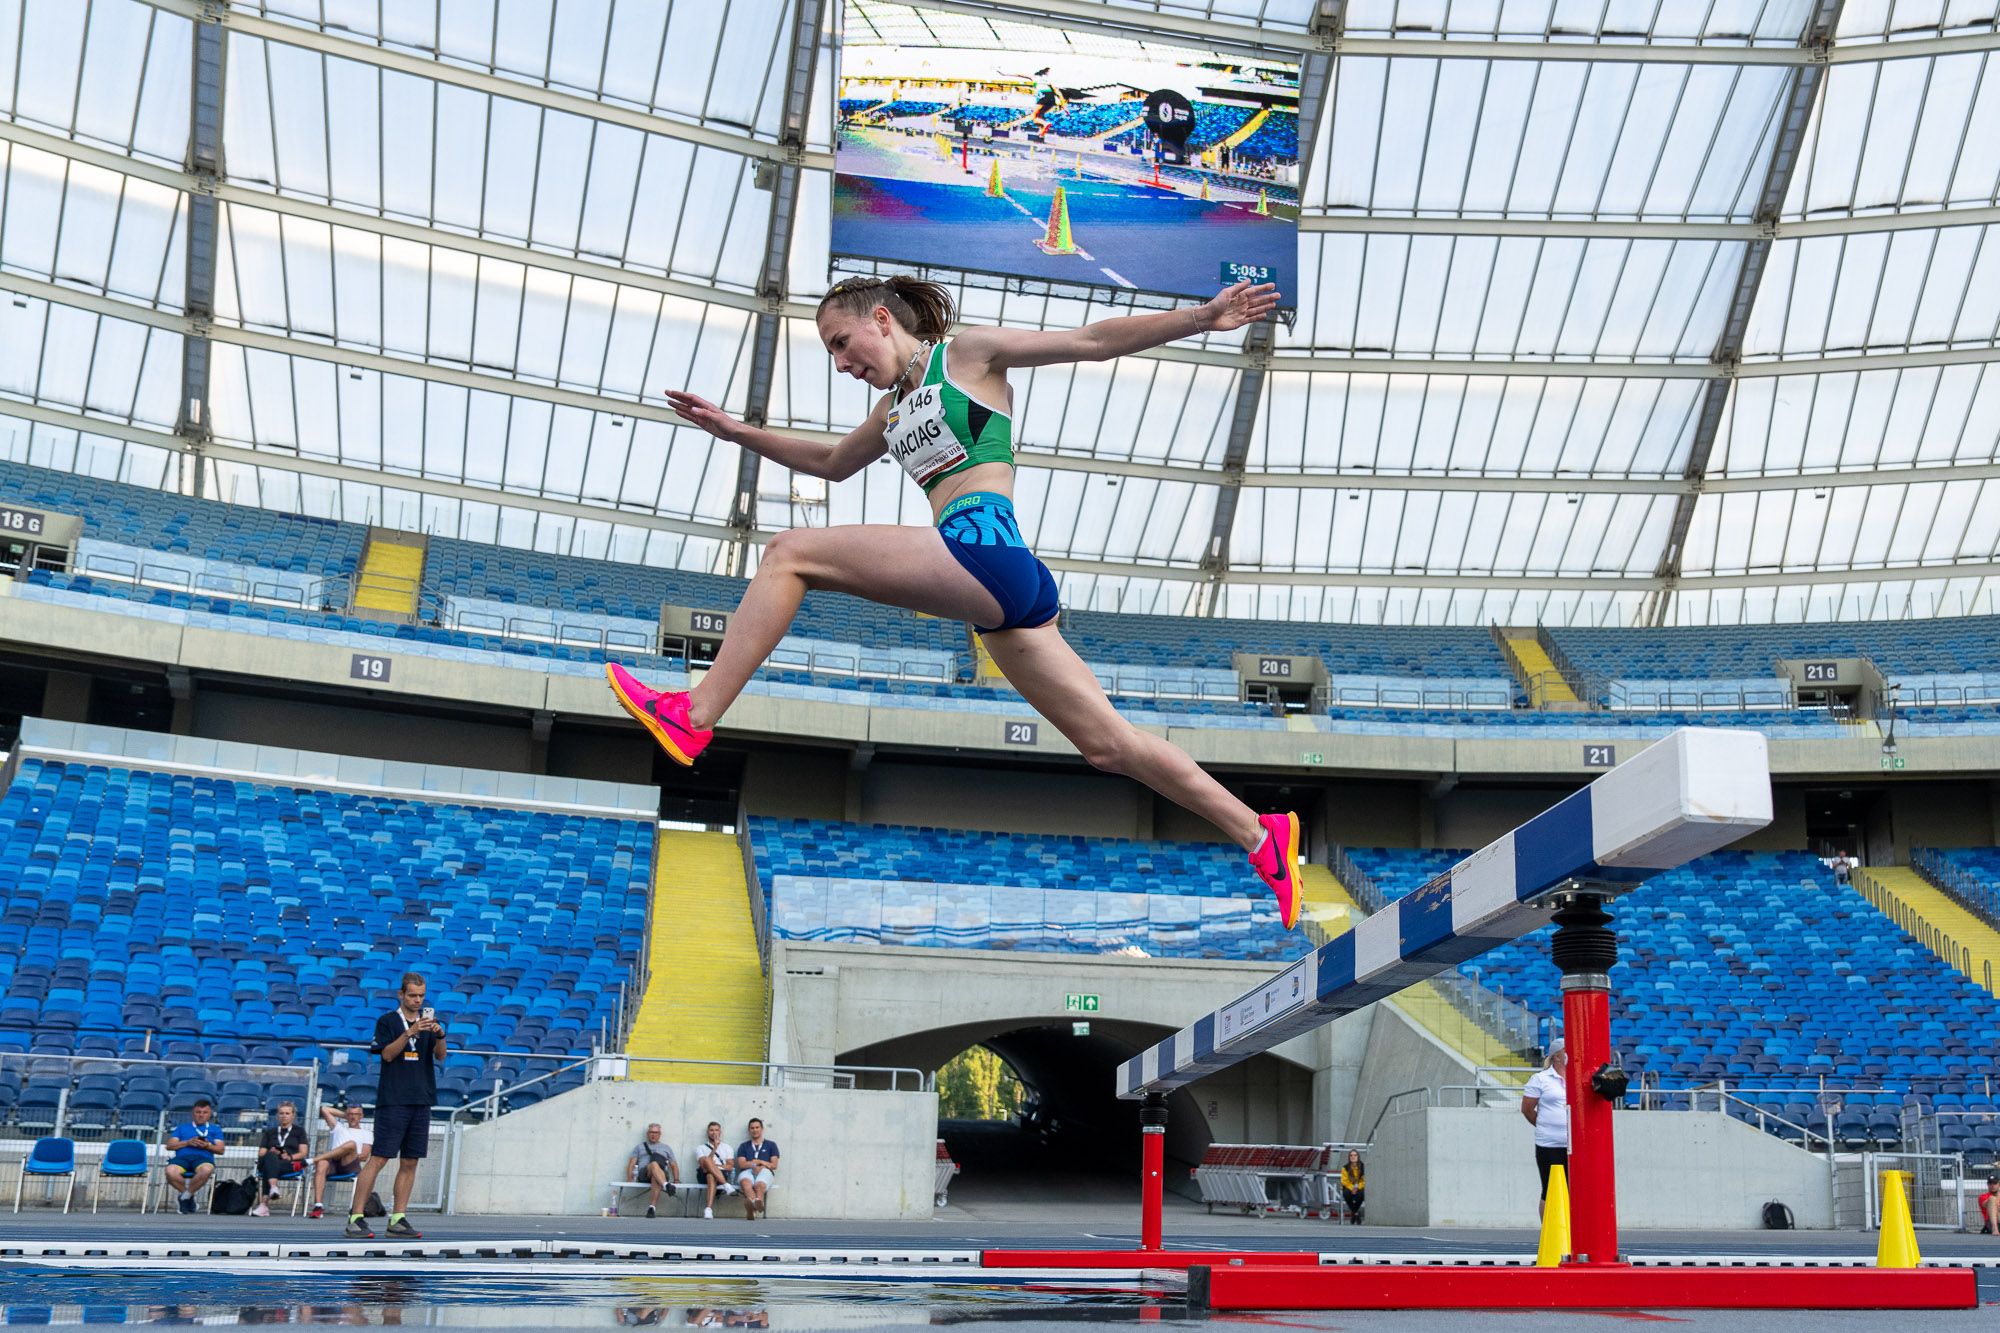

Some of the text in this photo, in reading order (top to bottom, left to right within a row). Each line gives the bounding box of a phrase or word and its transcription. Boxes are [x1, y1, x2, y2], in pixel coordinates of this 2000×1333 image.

[1230, 263, 1268, 278] 5:08.3
[908, 389, 933, 415] 146
[891, 418, 942, 462] MACIĄG
[948, 445, 962, 456] U18
[957, 495, 981, 509] PRO
[1, 511, 40, 531] 18 G
[694, 615, 724, 631] 19 G
[360, 658, 383, 678] 19
[1262, 660, 1289, 675] 20 G
[1807, 665, 1835, 679] 21 G
[1010, 725, 1031, 742] 20
[1590, 747, 1609, 764] 21
